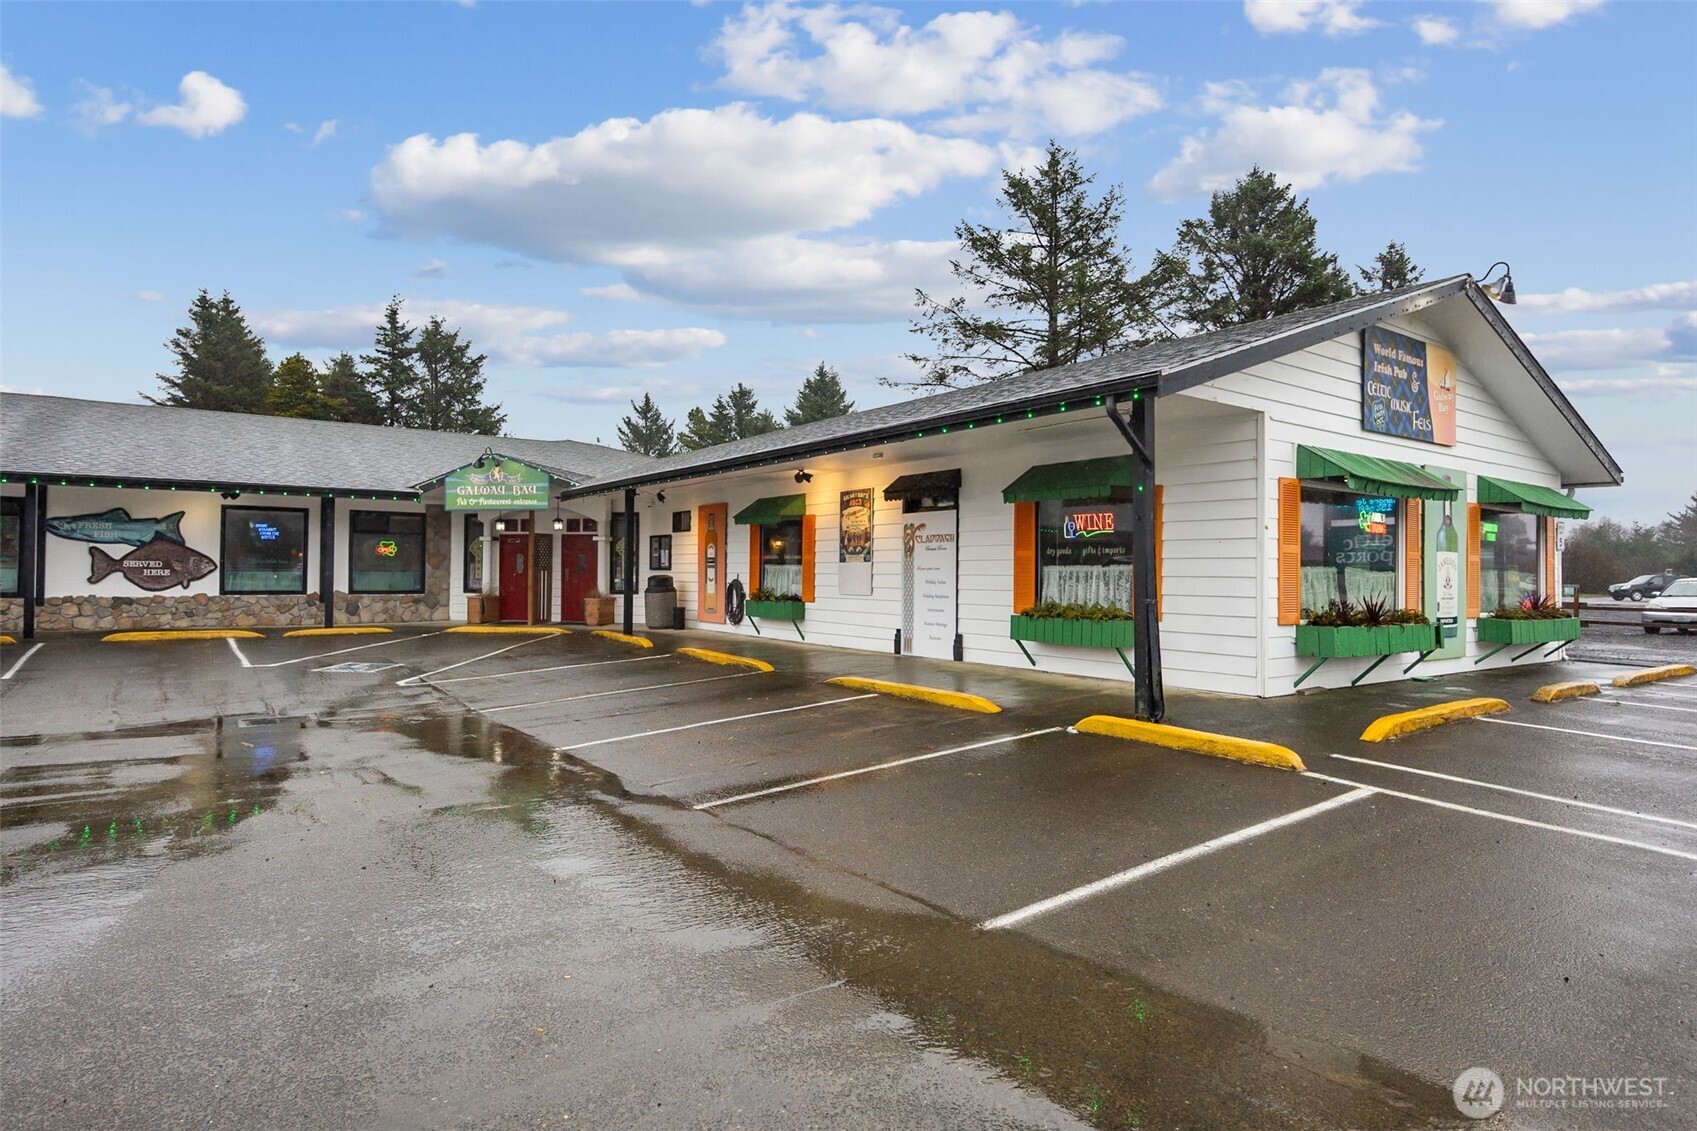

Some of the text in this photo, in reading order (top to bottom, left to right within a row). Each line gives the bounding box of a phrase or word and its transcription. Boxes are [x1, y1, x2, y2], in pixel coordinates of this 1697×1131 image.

[1373, 343, 1424, 367] World Famous
[1374, 361, 1420, 393] Irish Pub &
[457, 485, 537, 496] GALWAY BAY
[78, 522, 113, 530] FRESH
[1073, 513, 1114, 531] WINE
[915, 533, 955, 544] CLADDAGH
[1046, 547, 1055, 556] dry
[1056, 547, 1072, 556] goods
[1082, 546, 1096, 557] gifts
[1102, 546, 1126, 555] imports
[122, 560, 163, 568] SERVED
[143, 568, 171, 576] HERE
